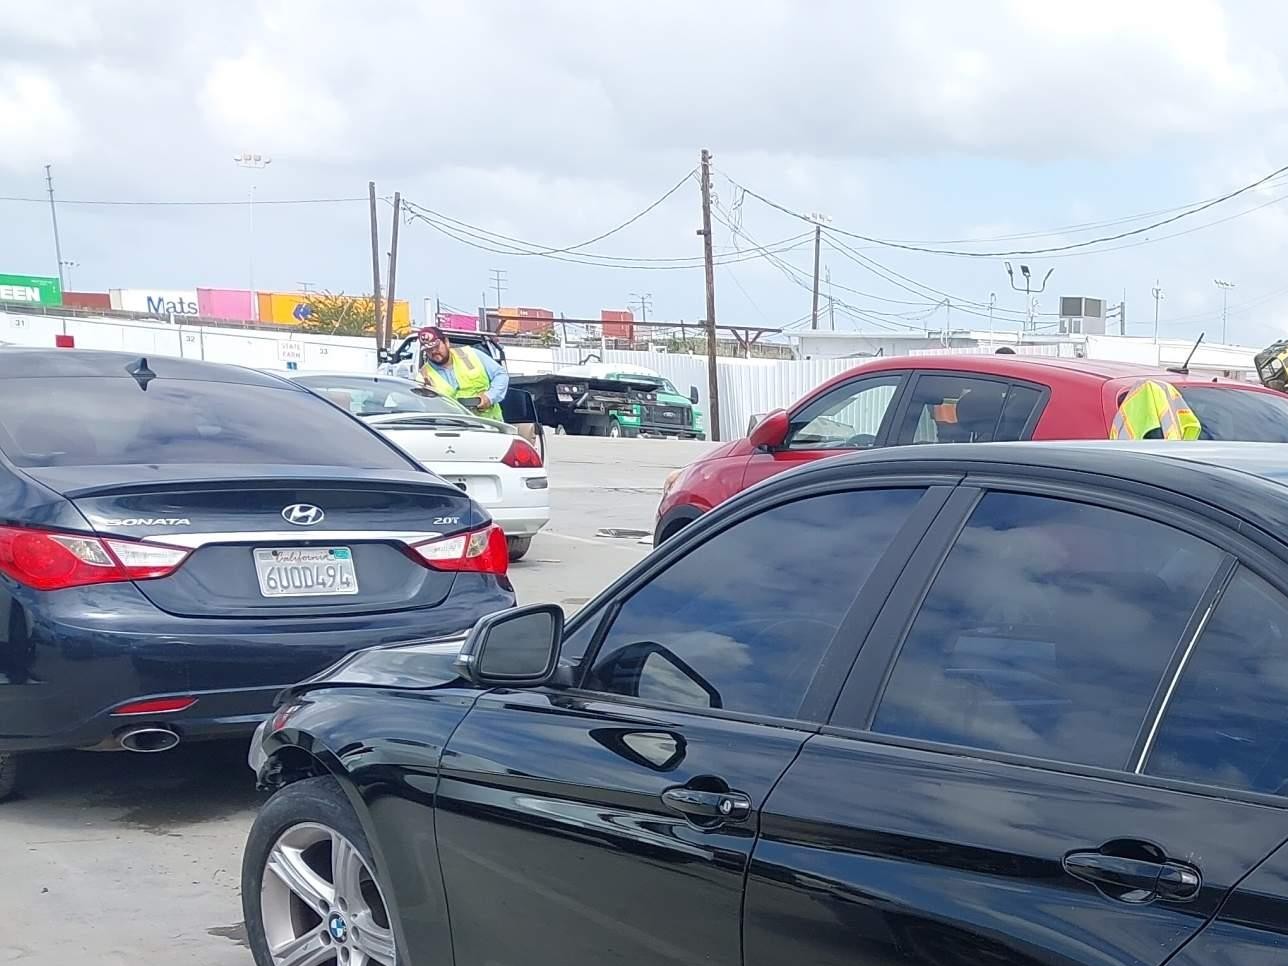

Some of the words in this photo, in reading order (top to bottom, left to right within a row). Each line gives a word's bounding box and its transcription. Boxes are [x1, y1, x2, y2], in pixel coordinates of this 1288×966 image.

[146, 295, 198, 314] Mats
[105, 518, 192, 527] SONATA
[275, 551, 334, 562] California
